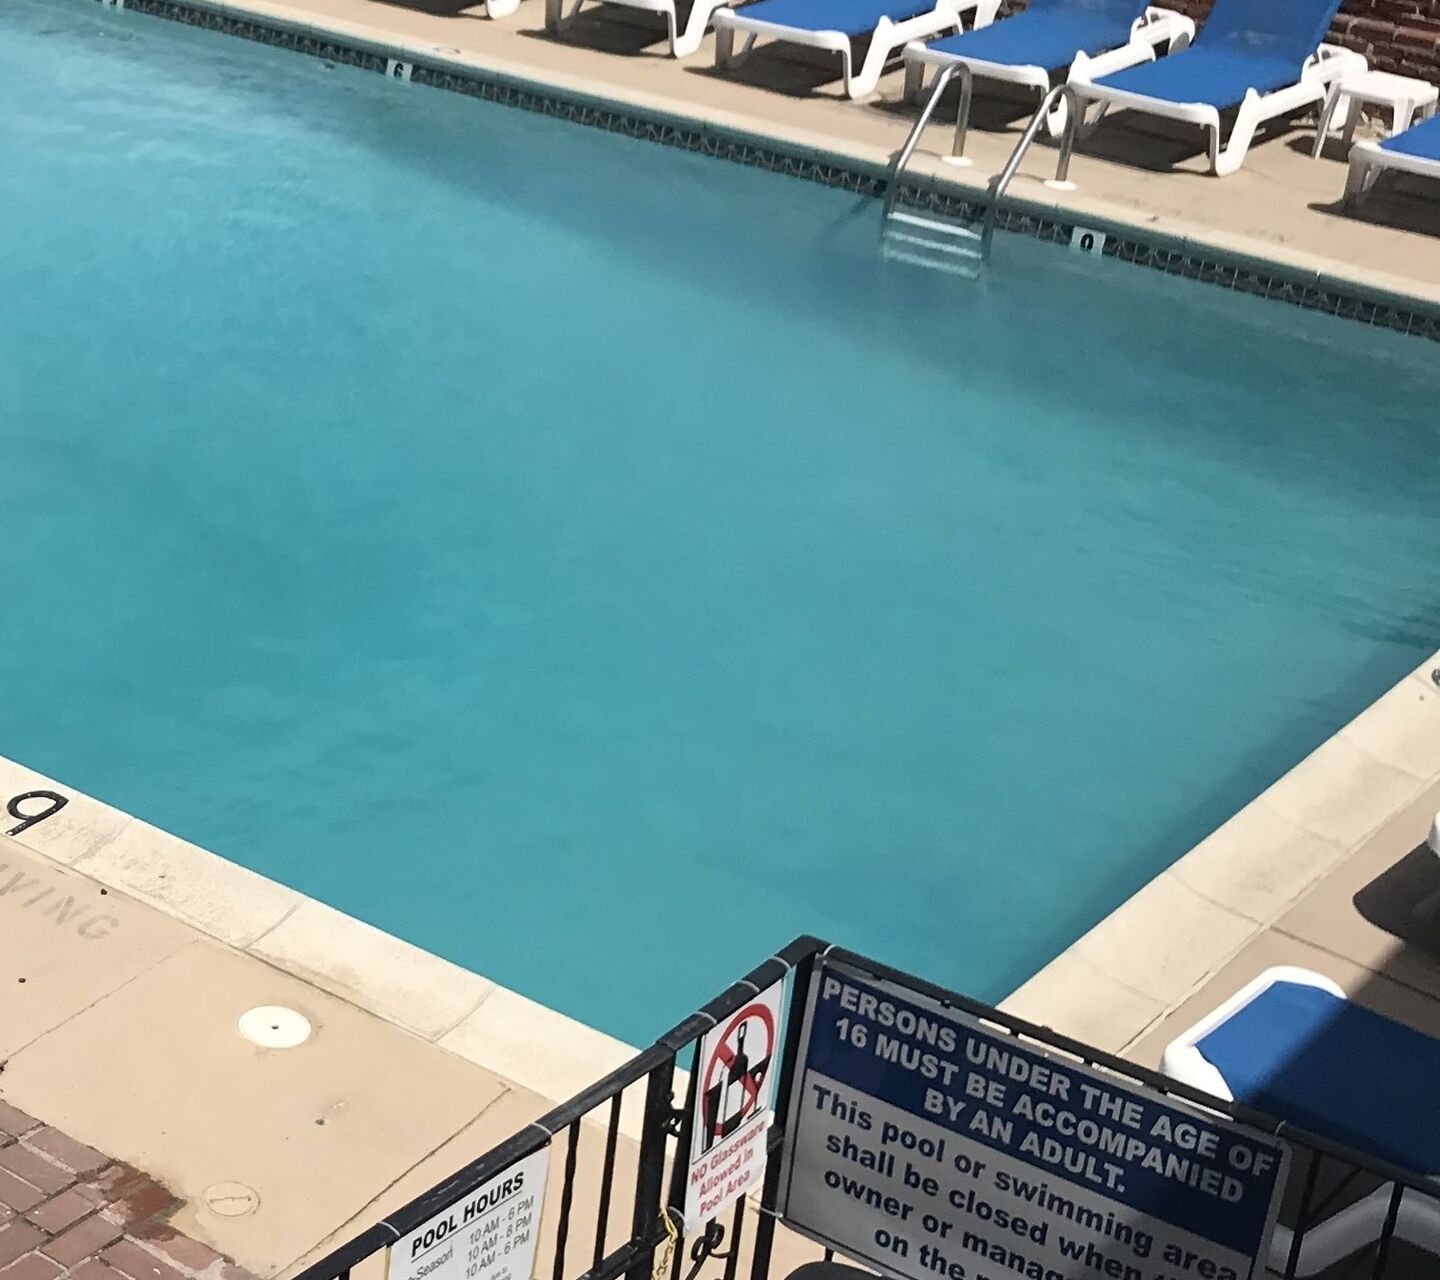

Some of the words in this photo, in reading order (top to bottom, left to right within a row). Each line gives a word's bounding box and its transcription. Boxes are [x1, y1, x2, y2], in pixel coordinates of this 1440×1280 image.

[6, 790, 69, 836] 9
[823, 976, 958, 1052] PERSONS
[966, 1037, 1071, 1101] UNDER
[1080, 1083, 1144, 1129] THE
[1150, 1115, 1220, 1158] AGE
[1228, 1144, 1274, 1176] OF
[836, 1017, 868, 1048] 16
[875, 1033, 959, 1086] MUST
[966, 1071, 1007, 1107] BE
[1012, 1094, 1244, 1203] ACCOMPANIED
[924, 1087, 966, 1121] BY
[969, 1109, 1014, 1144] AN
[1019, 1131, 1124, 1193] ADULT.
[691, 1163, 707, 1185] NO
[710, 1120, 765, 1169] Glassware
[699, 1155, 741, 1198] Allowed
[813, 1084, 872, 1131] This
[881, 1121, 945, 1162] pool
[954, 1154, 986, 1179] or
[994, 1170, 1153, 1258] swimming
[411, 1214, 458, 1257] POOL
[463, 1171, 524, 1223] HOURS
[470, 1228, 481, 1245] 10
[483, 1216, 499, 1237] AM
[517, 1194, 534, 1215] PM
[699, 1187, 723, 1217] Pool
[726, 1170, 750, 1196] Area
[824, 1170, 913, 1221] owner
[922, 1214, 953, 1239] or
[826, 1133, 895, 1178] shall
[904, 1162, 940, 1196] be
[949, 1188, 1048, 1246] closed
[466, 1262, 478, 1279] 10
[479, 1250, 496, 1271] AM
[513, 1229, 530, 1249] PM
[468, 1245, 480, 1262] 10
[481, 1234, 498, 1254] AM
[515, 1212, 532, 1232] PM
[875, 1228, 909, 1257] on
